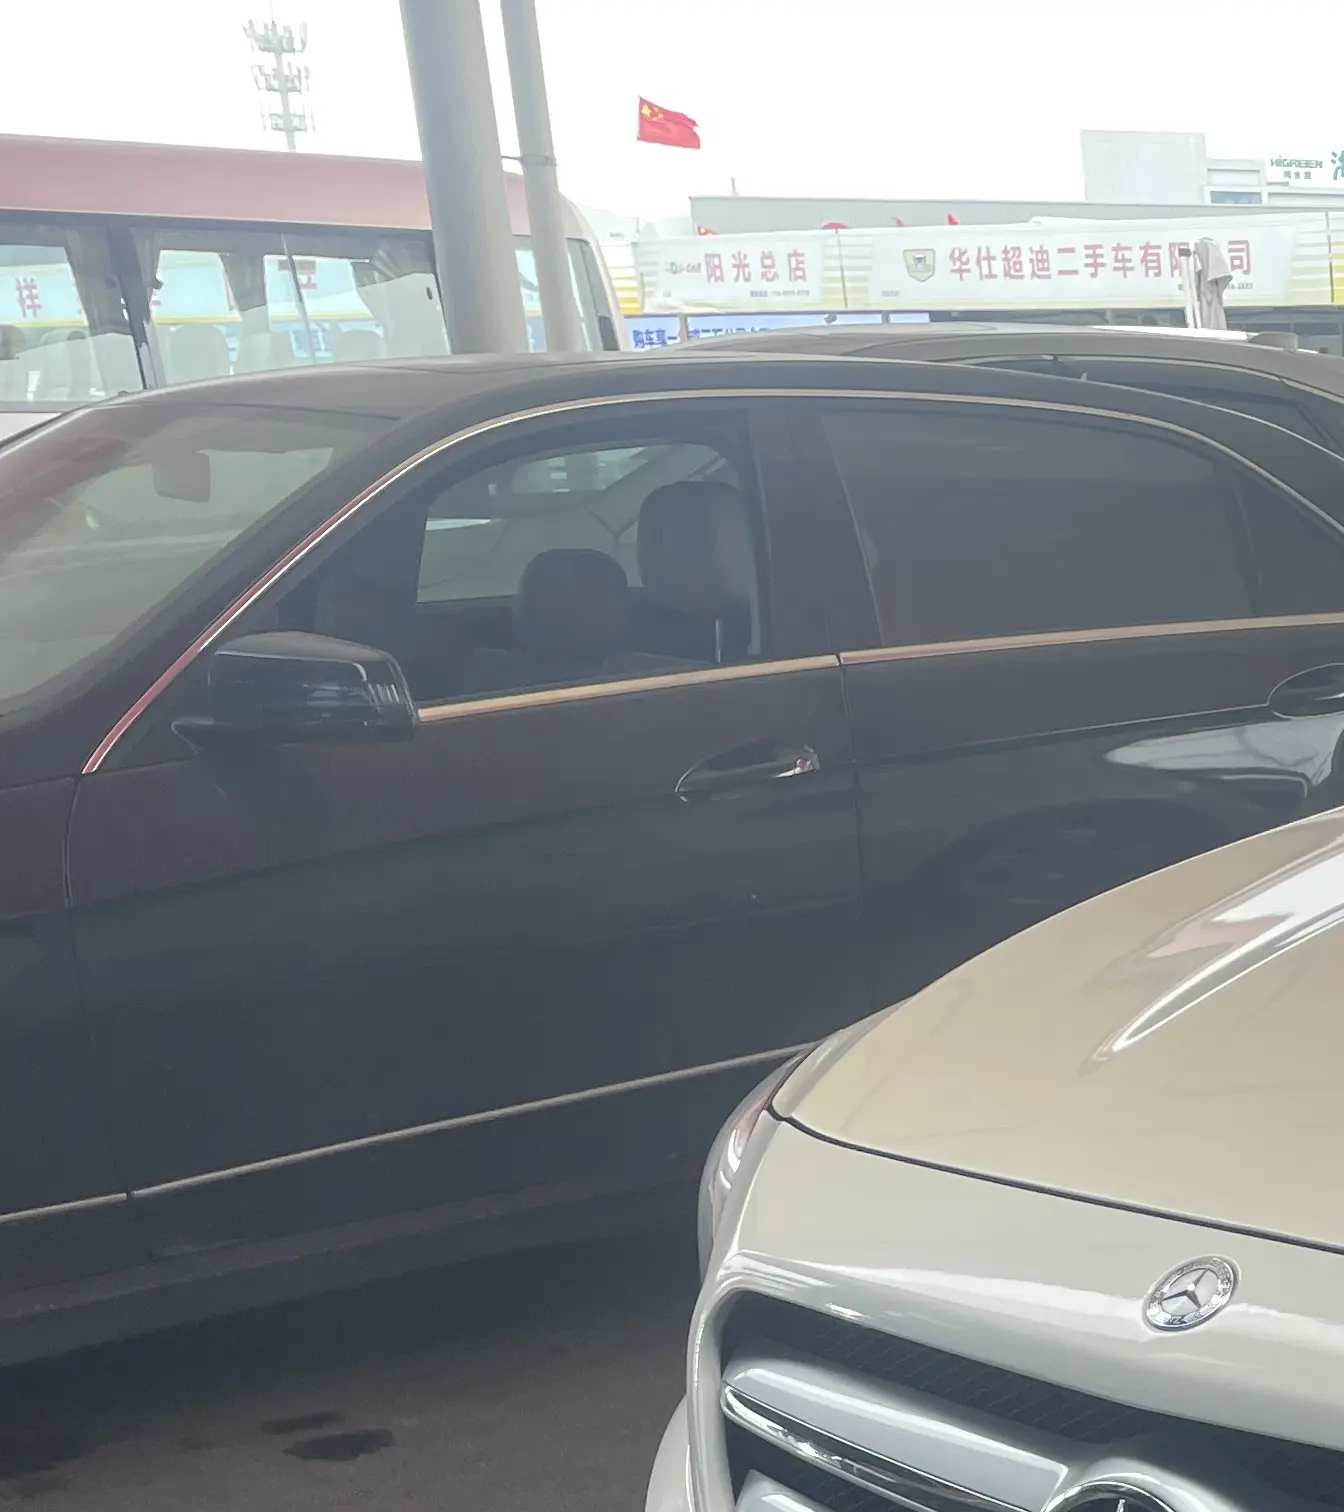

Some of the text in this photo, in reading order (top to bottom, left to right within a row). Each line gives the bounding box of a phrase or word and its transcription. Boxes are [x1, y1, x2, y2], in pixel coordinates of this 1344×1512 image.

[704, 249, 807, 283] 阳光总店
[949, 240, 1251, 281] 华仕超迪二手车有限司
